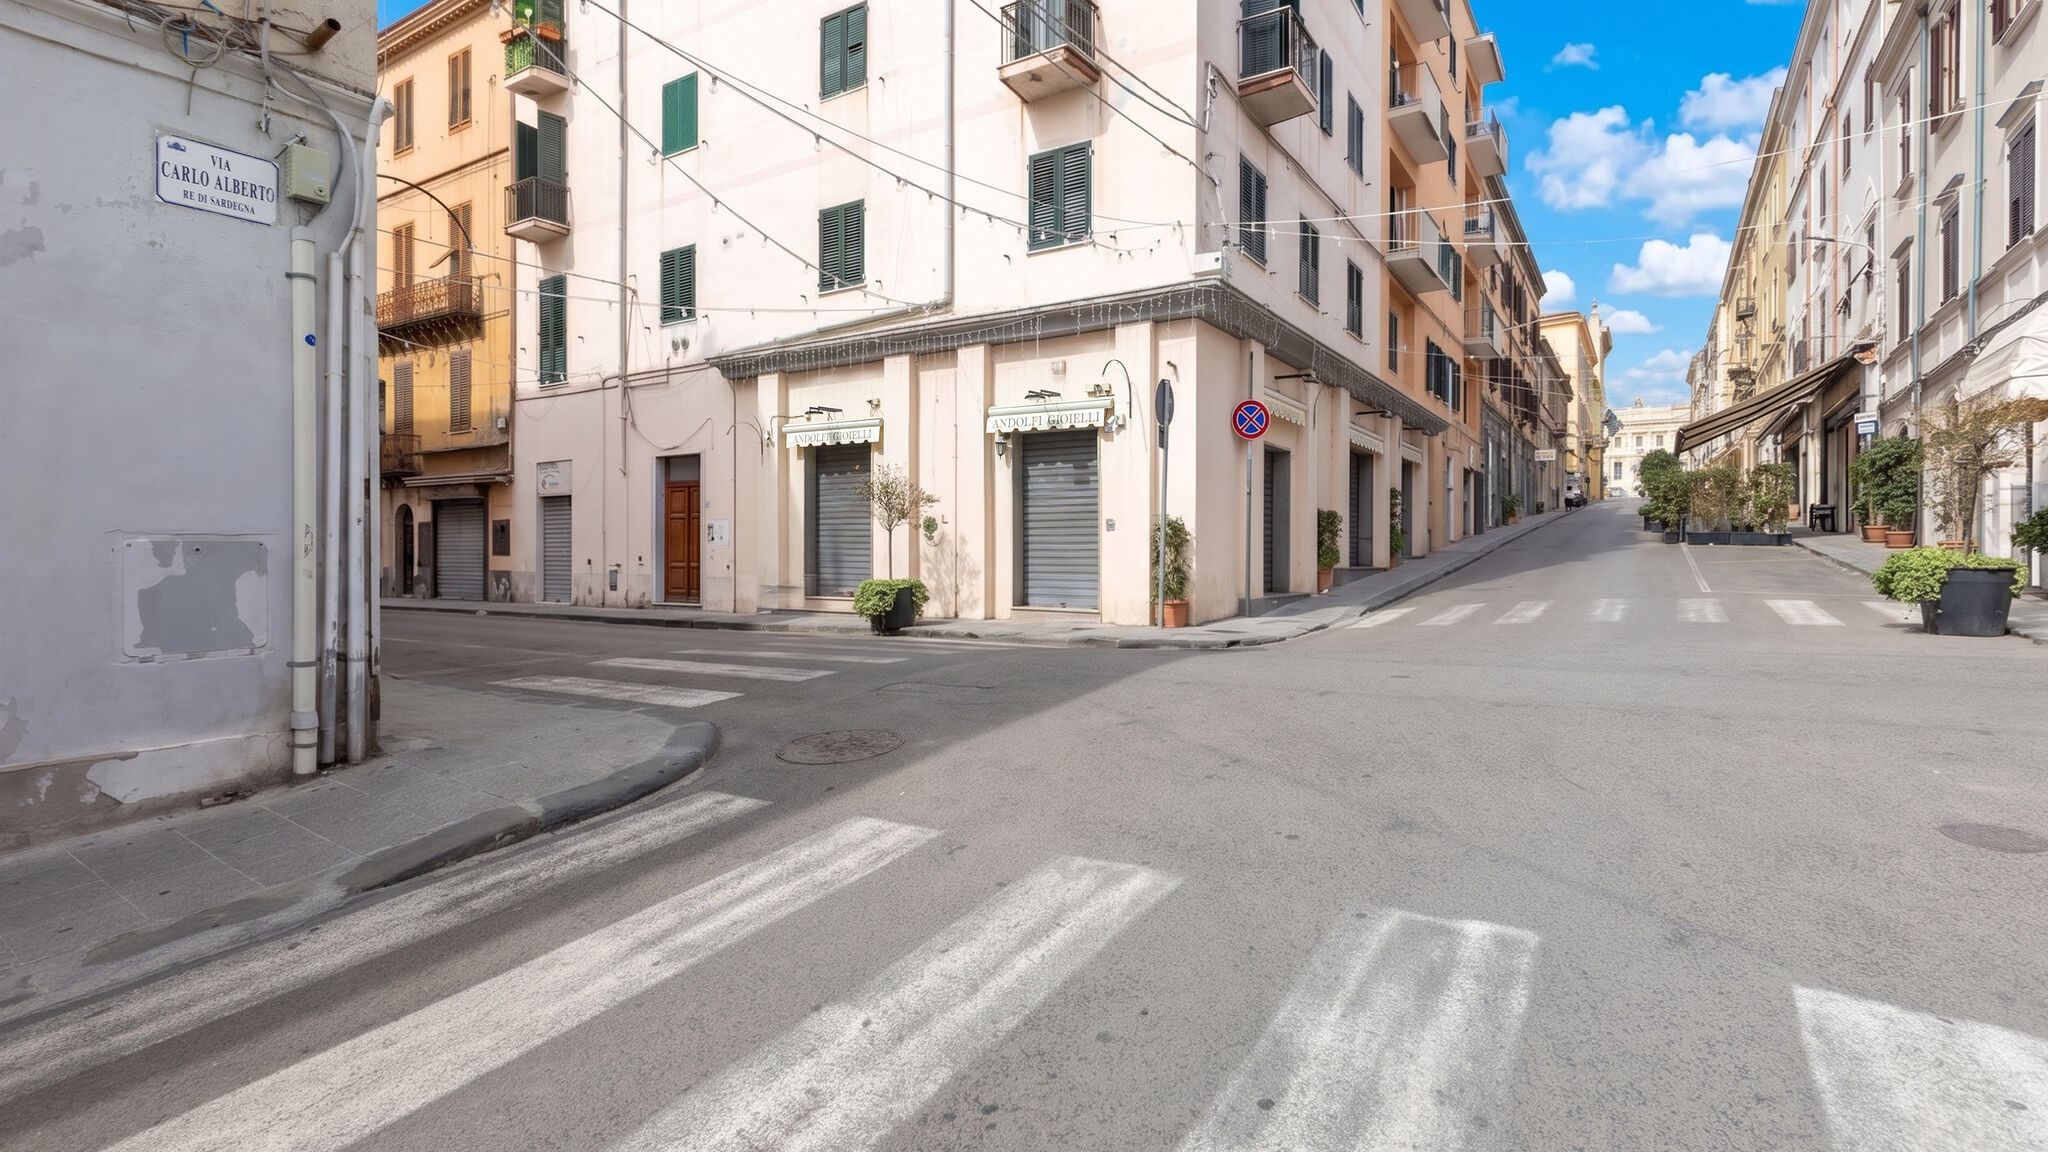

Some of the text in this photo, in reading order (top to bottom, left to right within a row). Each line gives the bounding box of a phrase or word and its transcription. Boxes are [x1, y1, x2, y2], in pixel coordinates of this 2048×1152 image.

[211, 154, 232, 172] VIA
[161, 160, 275, 203] CARLO ALBERTO
[183, 189, 256, 215] RE DI SARDEGNA
[992, 411, 1100, 429] ANDOLFI GIOIELLI
[792, 428, 872, 444] ANDOLFI GIOIELLI
